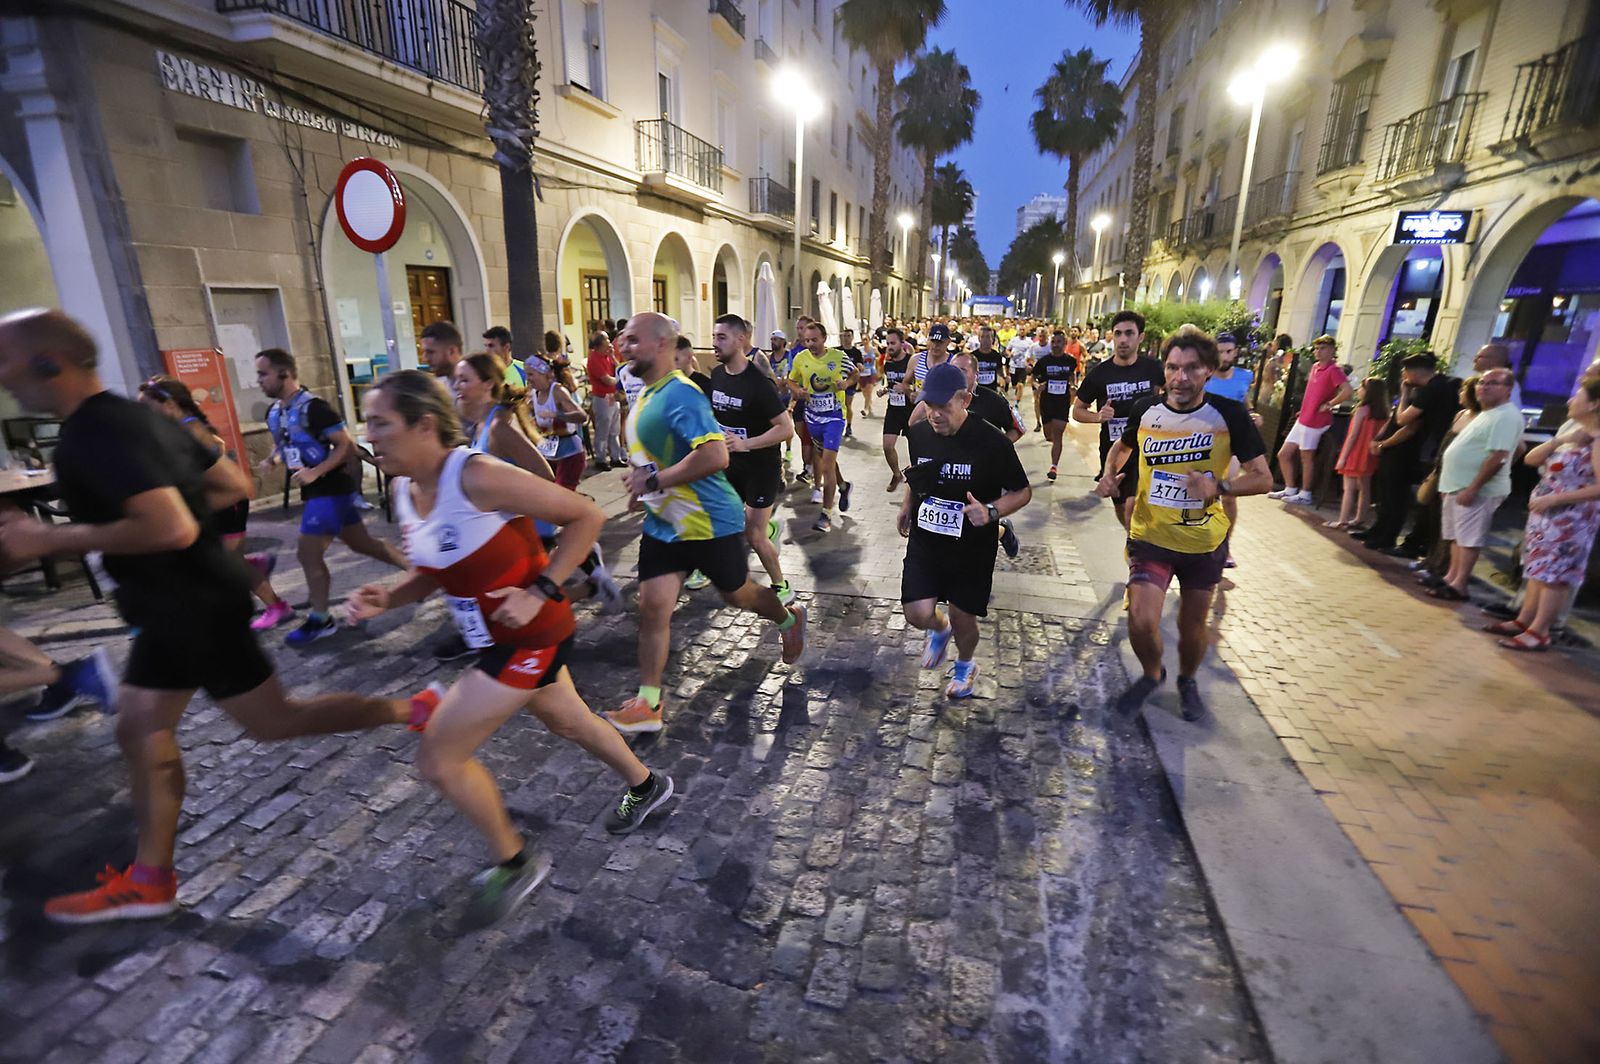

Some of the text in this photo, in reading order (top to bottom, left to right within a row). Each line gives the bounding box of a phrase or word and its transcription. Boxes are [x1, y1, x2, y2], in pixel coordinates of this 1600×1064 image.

[162, 53, 265, 97] AVENIDA
[162, 70, 255, 111] MARTIN
[1143, 432, 1213, 454] Carrerita
[952, 464, 972, 475] FUN
[1150, 452, 1203, 465] Y TERSIO
